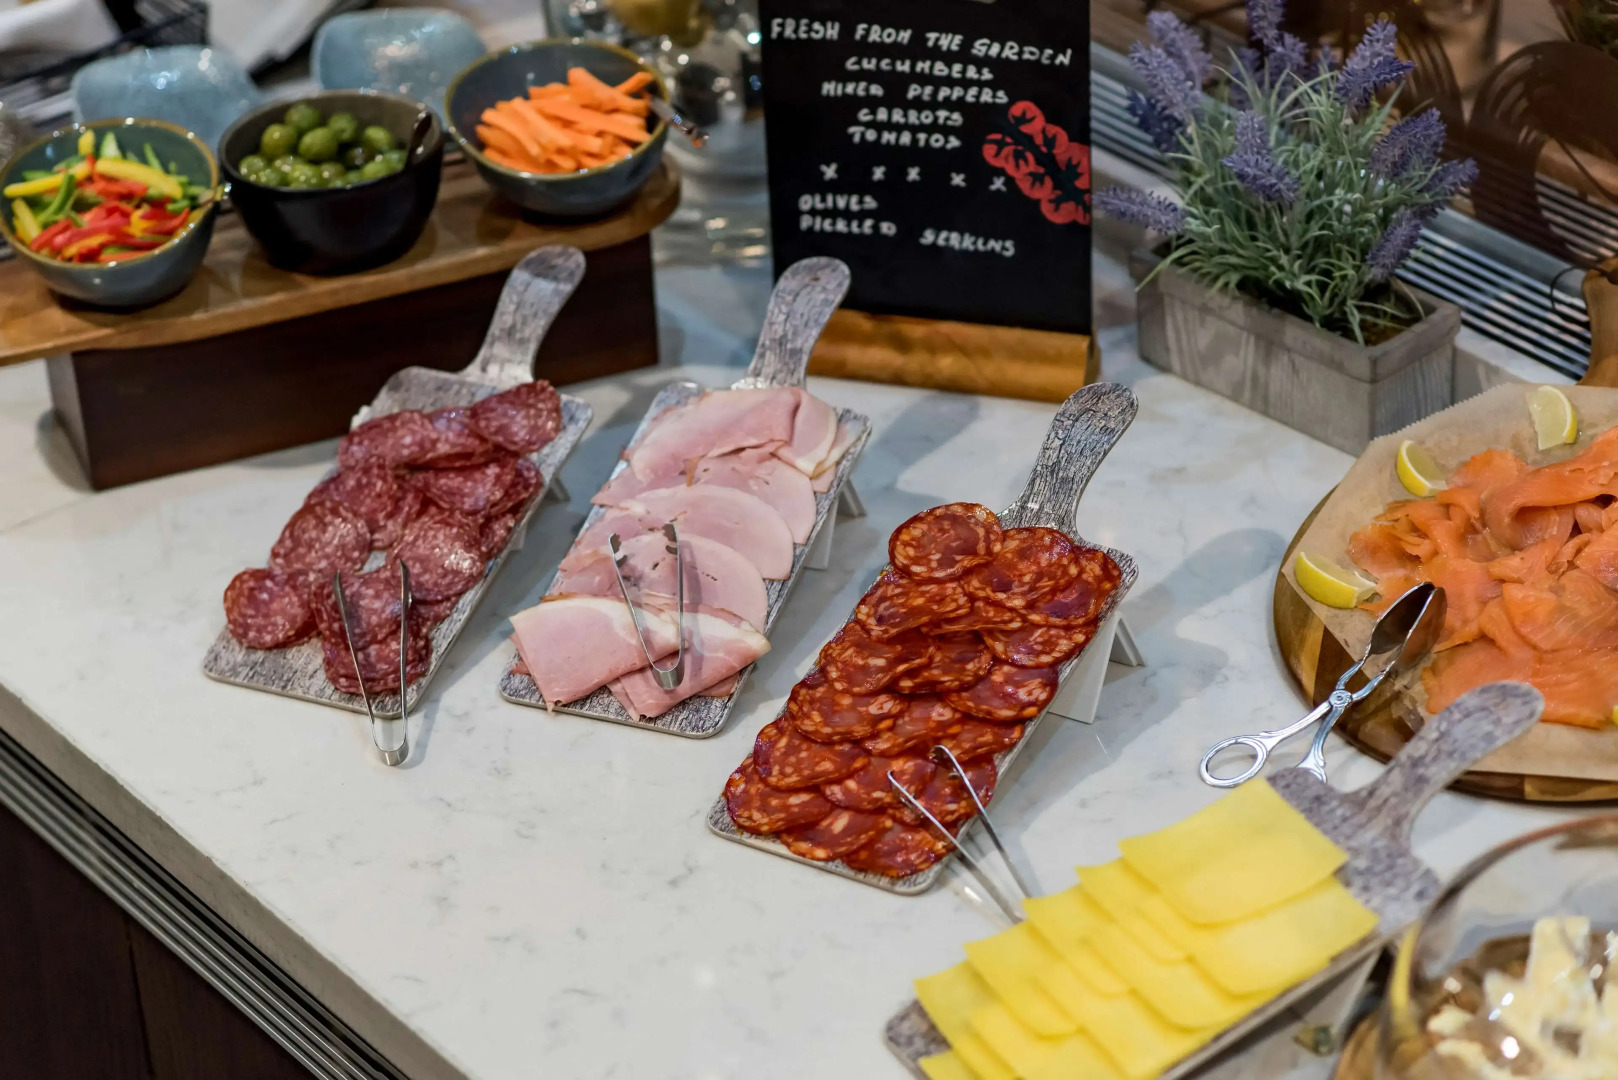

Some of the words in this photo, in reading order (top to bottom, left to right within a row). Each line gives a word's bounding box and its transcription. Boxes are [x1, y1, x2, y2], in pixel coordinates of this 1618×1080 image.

[771, 17, 840, 40] FRESH
[854, 23, 912, 45] FROM
[925, 31, 964, 51] THE
[970, 37, 1072, 66] GARDEN
[845, 55, 995, 81] CUCUMBERS
[821, 80, 884, 97] MIXED
[906, 83, 1009, 104] PEPPERS
[857, 106, 963, 126] CARROTS
[799, 193, 877, 212] OLIVES
[800, 214, 897, 236] PICKLED
